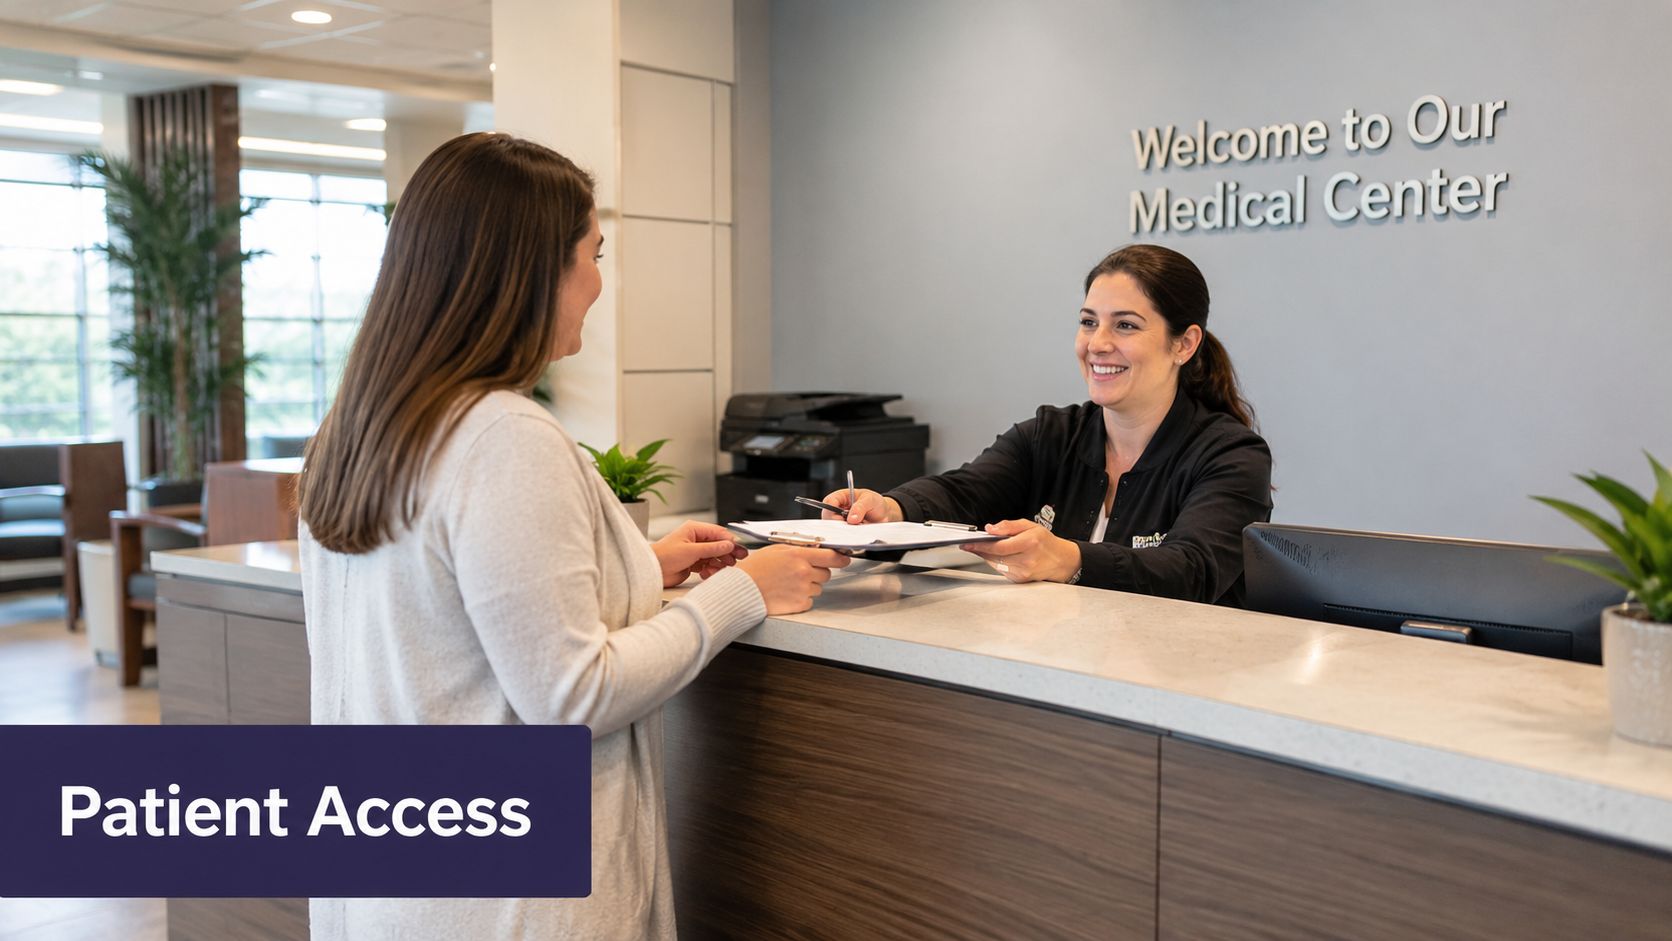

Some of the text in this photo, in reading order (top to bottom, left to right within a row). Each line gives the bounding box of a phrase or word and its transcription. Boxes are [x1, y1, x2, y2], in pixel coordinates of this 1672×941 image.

[1131, 94, 1507, 171] Welcome to Our
[1128, 168, 1509, 235] Medical Center
